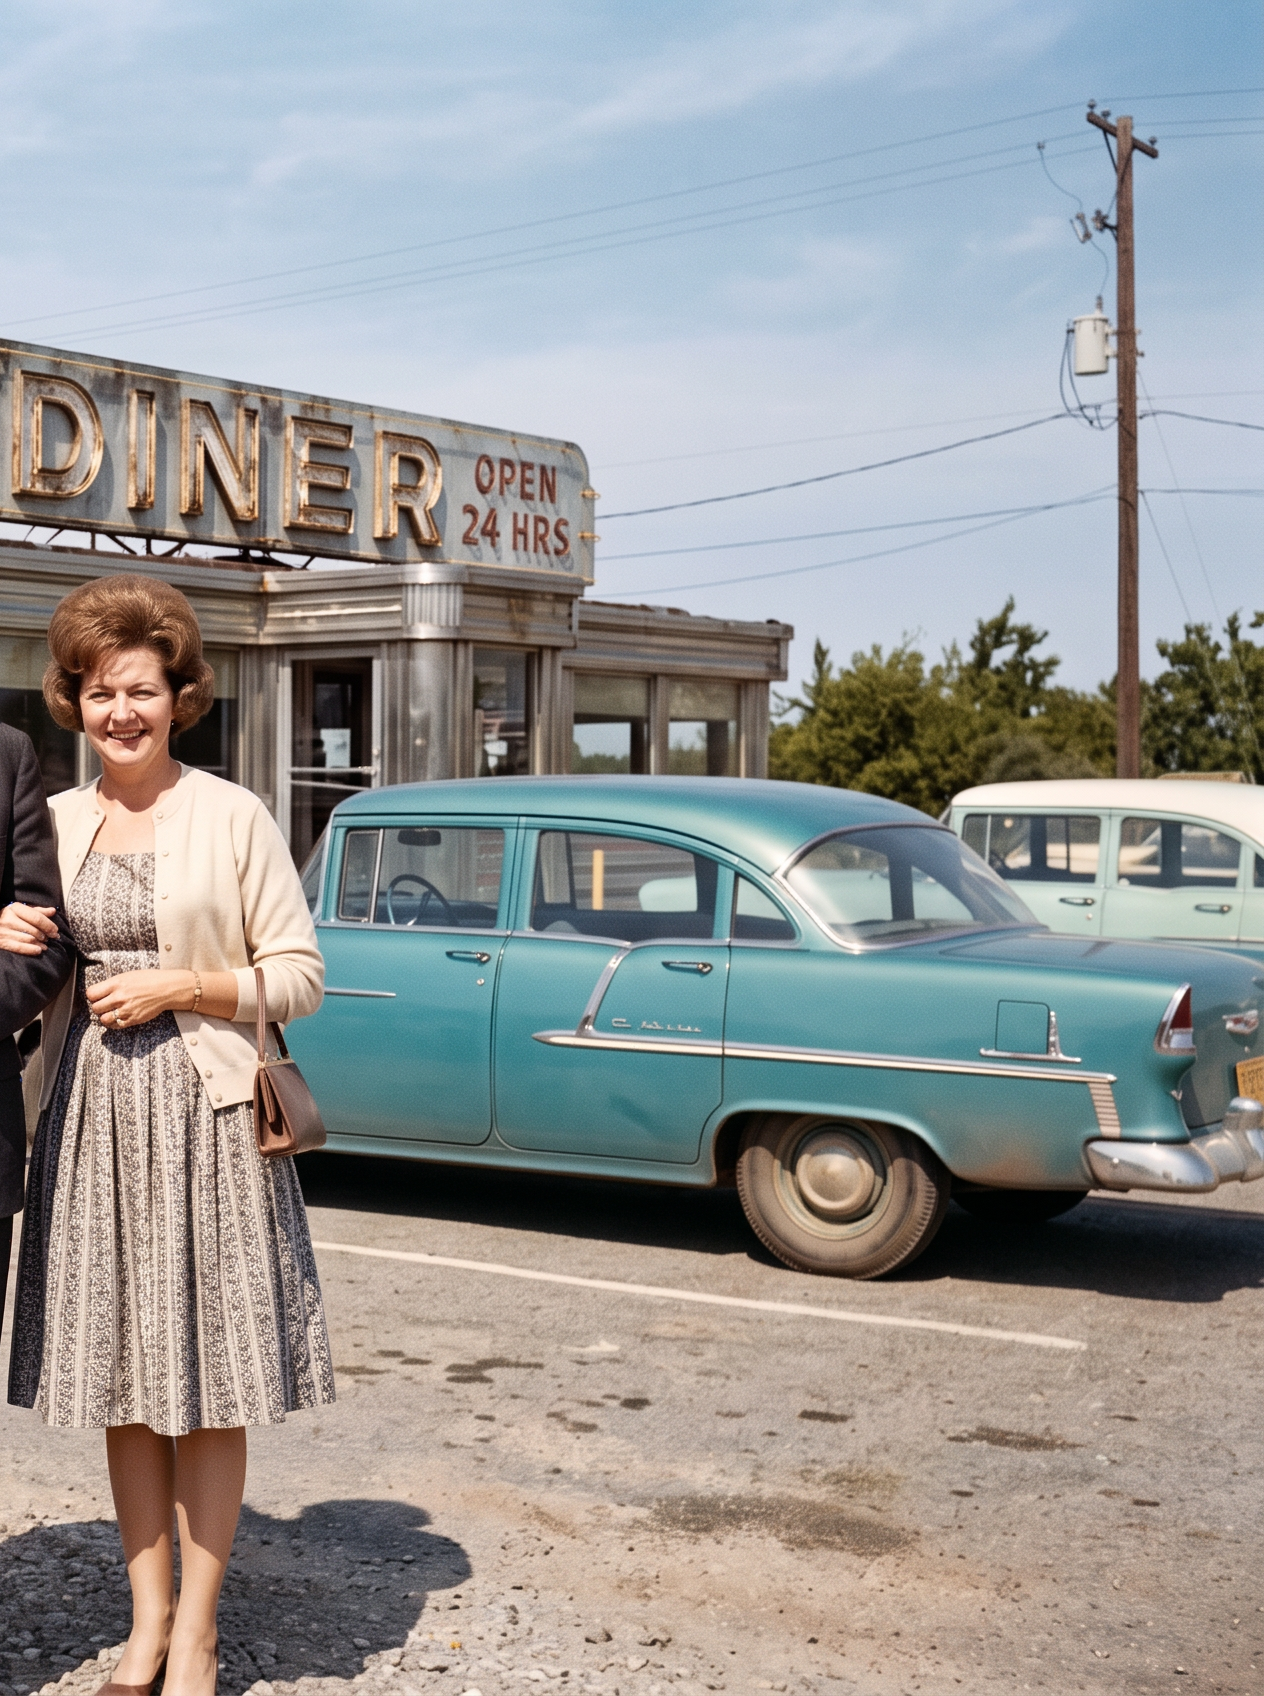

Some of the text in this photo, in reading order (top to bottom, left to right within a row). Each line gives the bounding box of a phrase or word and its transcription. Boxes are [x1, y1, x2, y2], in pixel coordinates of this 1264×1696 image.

[11, 369, 443, 546] DINER
[474, 453, 557, 504] OPEN
[462, 503, 571, 556] 24 HRS
